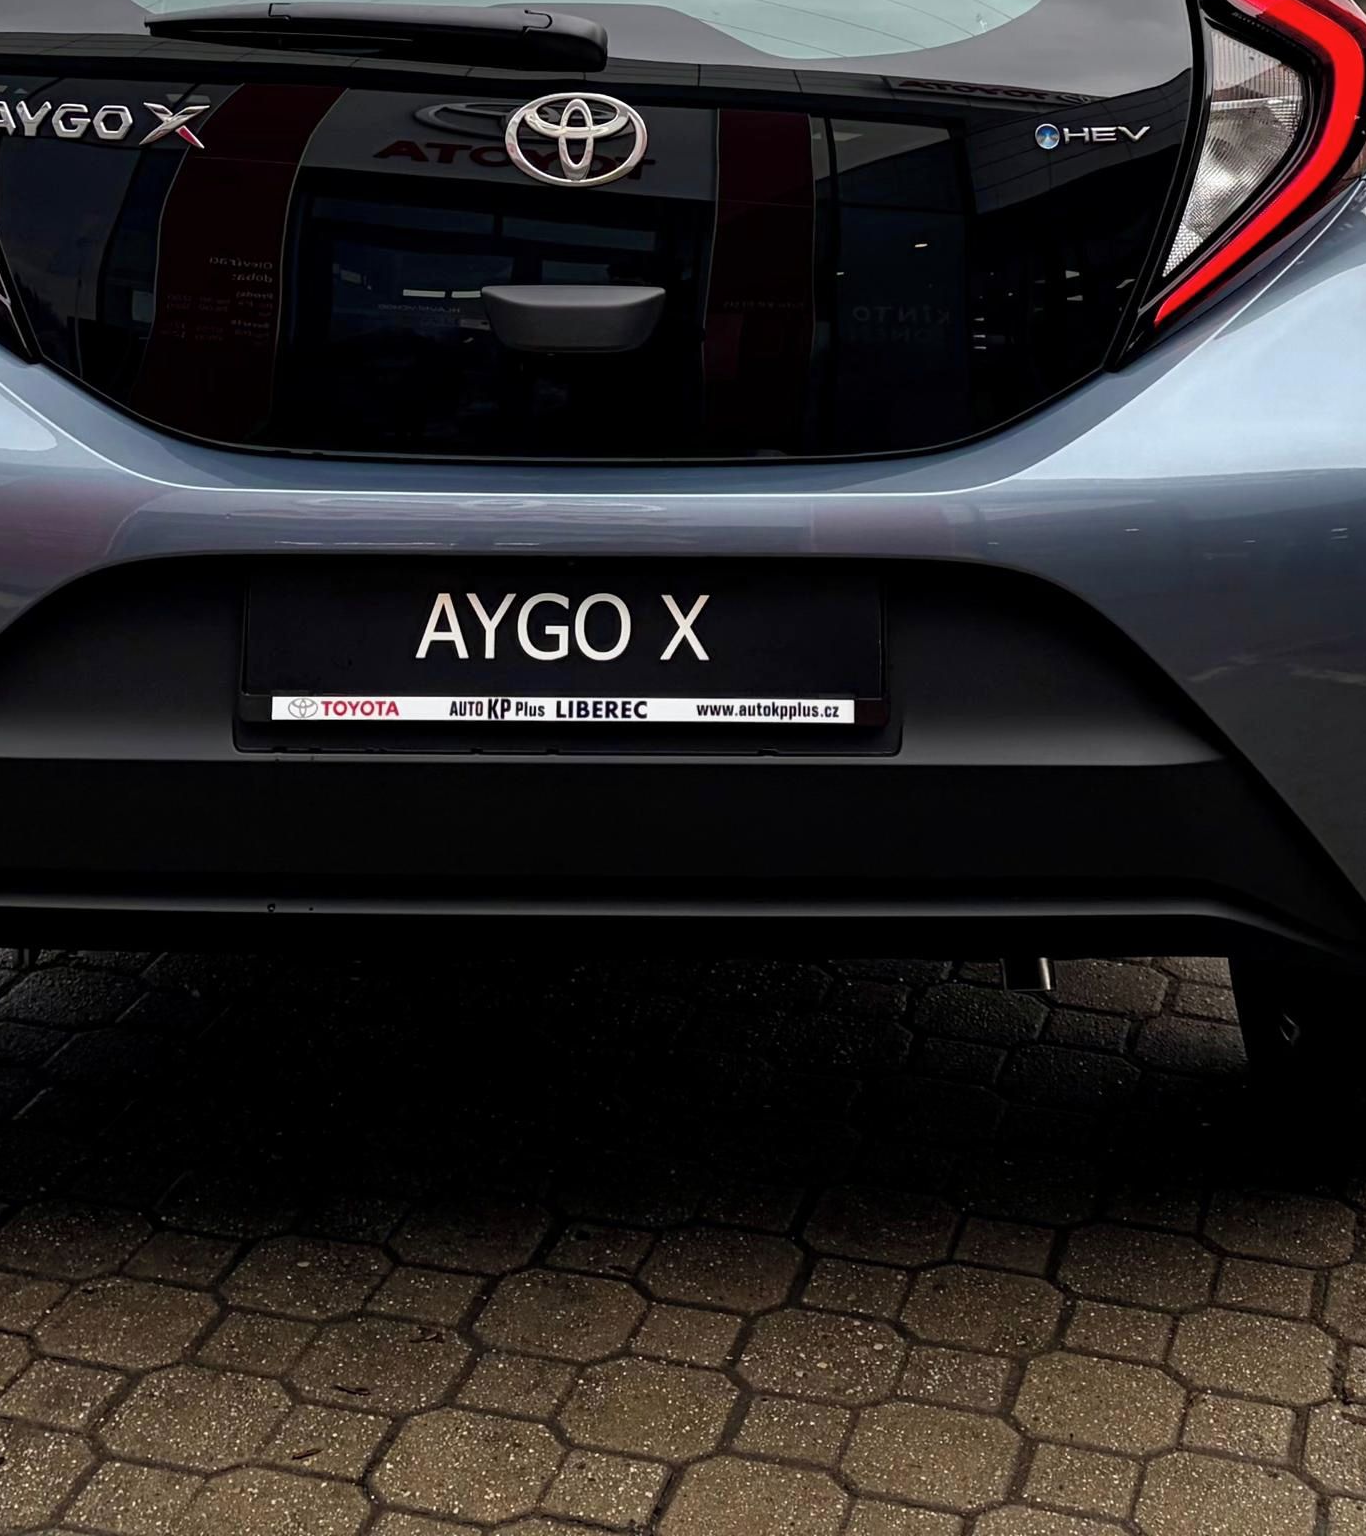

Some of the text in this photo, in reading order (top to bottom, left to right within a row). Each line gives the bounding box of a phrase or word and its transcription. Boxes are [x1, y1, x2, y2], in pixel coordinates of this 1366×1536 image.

[139, 101, 211, 149] X
[1063, 126, 1151, 144] HEV
[415, 592, 710, 661] AYGO X
[321, 697, 840, 721] TOYOTA AUTO KP Plus LIBEREC www.autokpplus.cz
